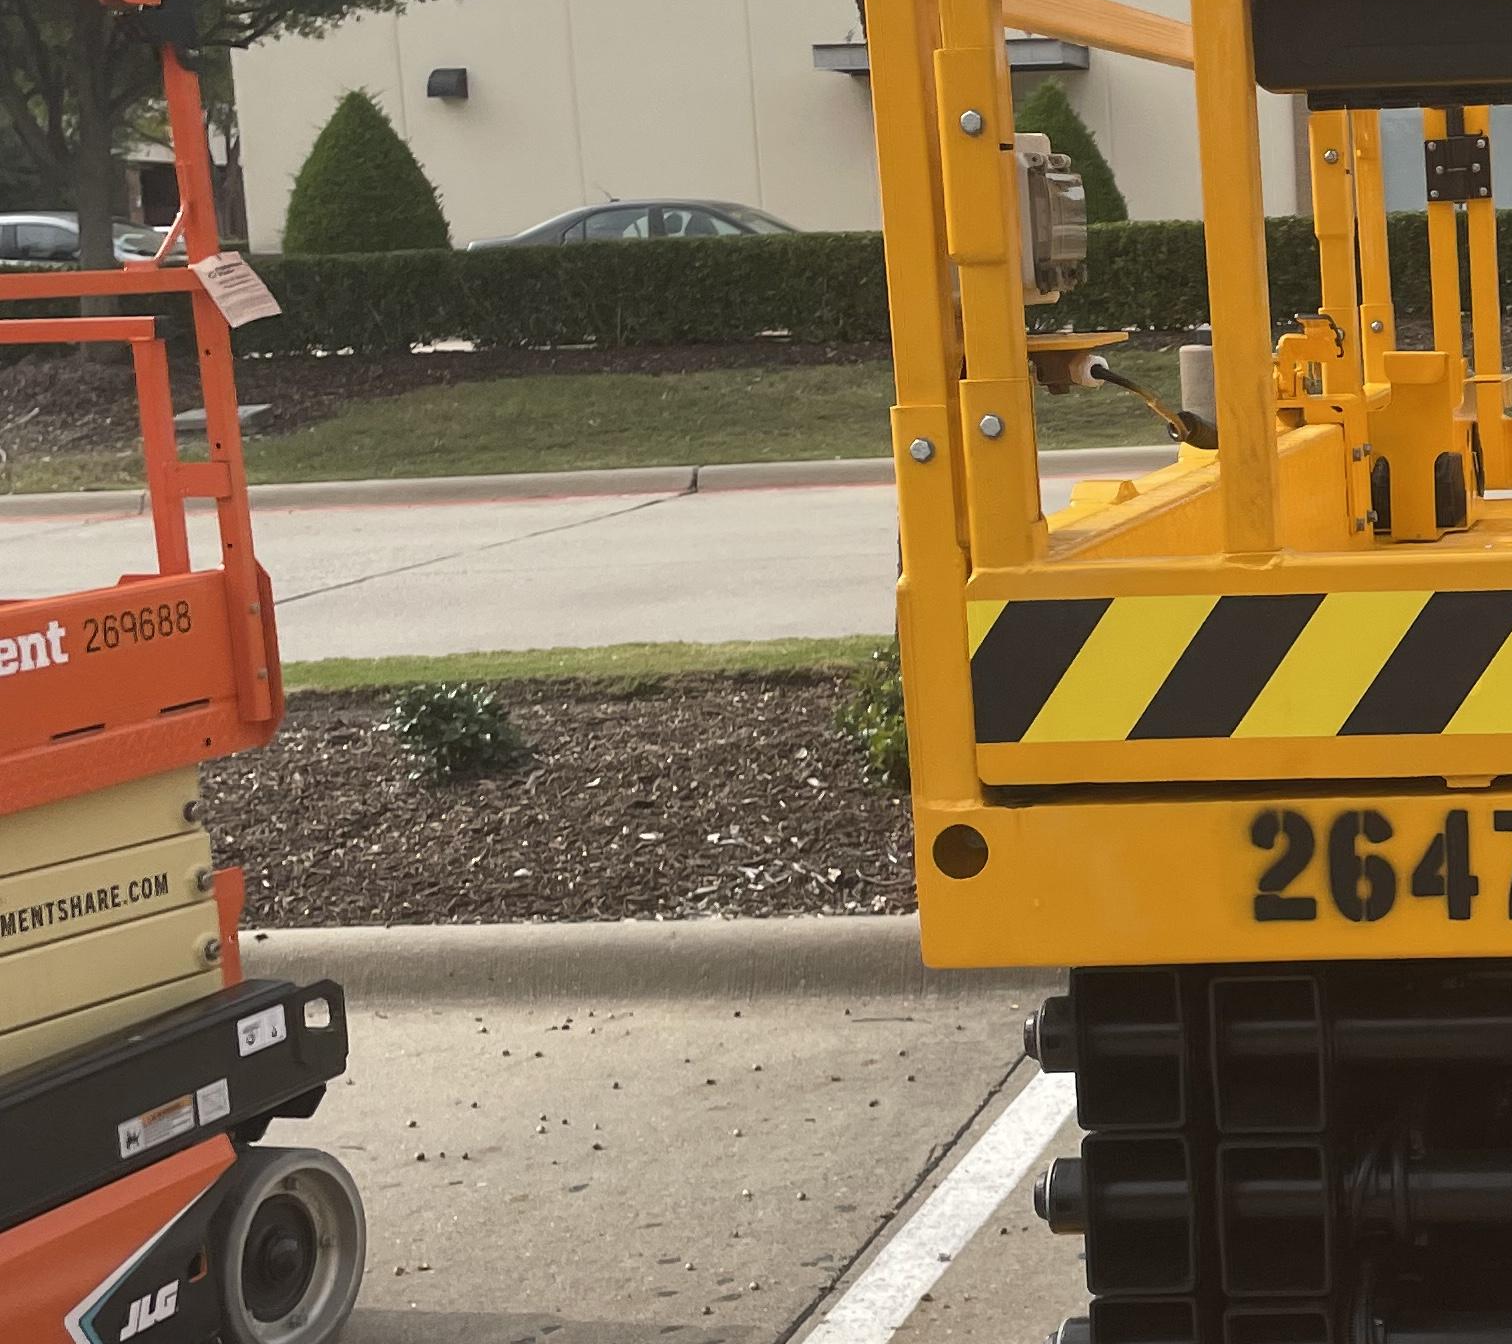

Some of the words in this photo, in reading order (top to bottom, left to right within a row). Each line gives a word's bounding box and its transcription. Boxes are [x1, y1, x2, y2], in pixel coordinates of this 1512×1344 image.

[83, 600, 192, 654] 269688
[0, 872, 169, 937] MENTSHARE.COM
[120, 1278, 179, 1343] JLG
